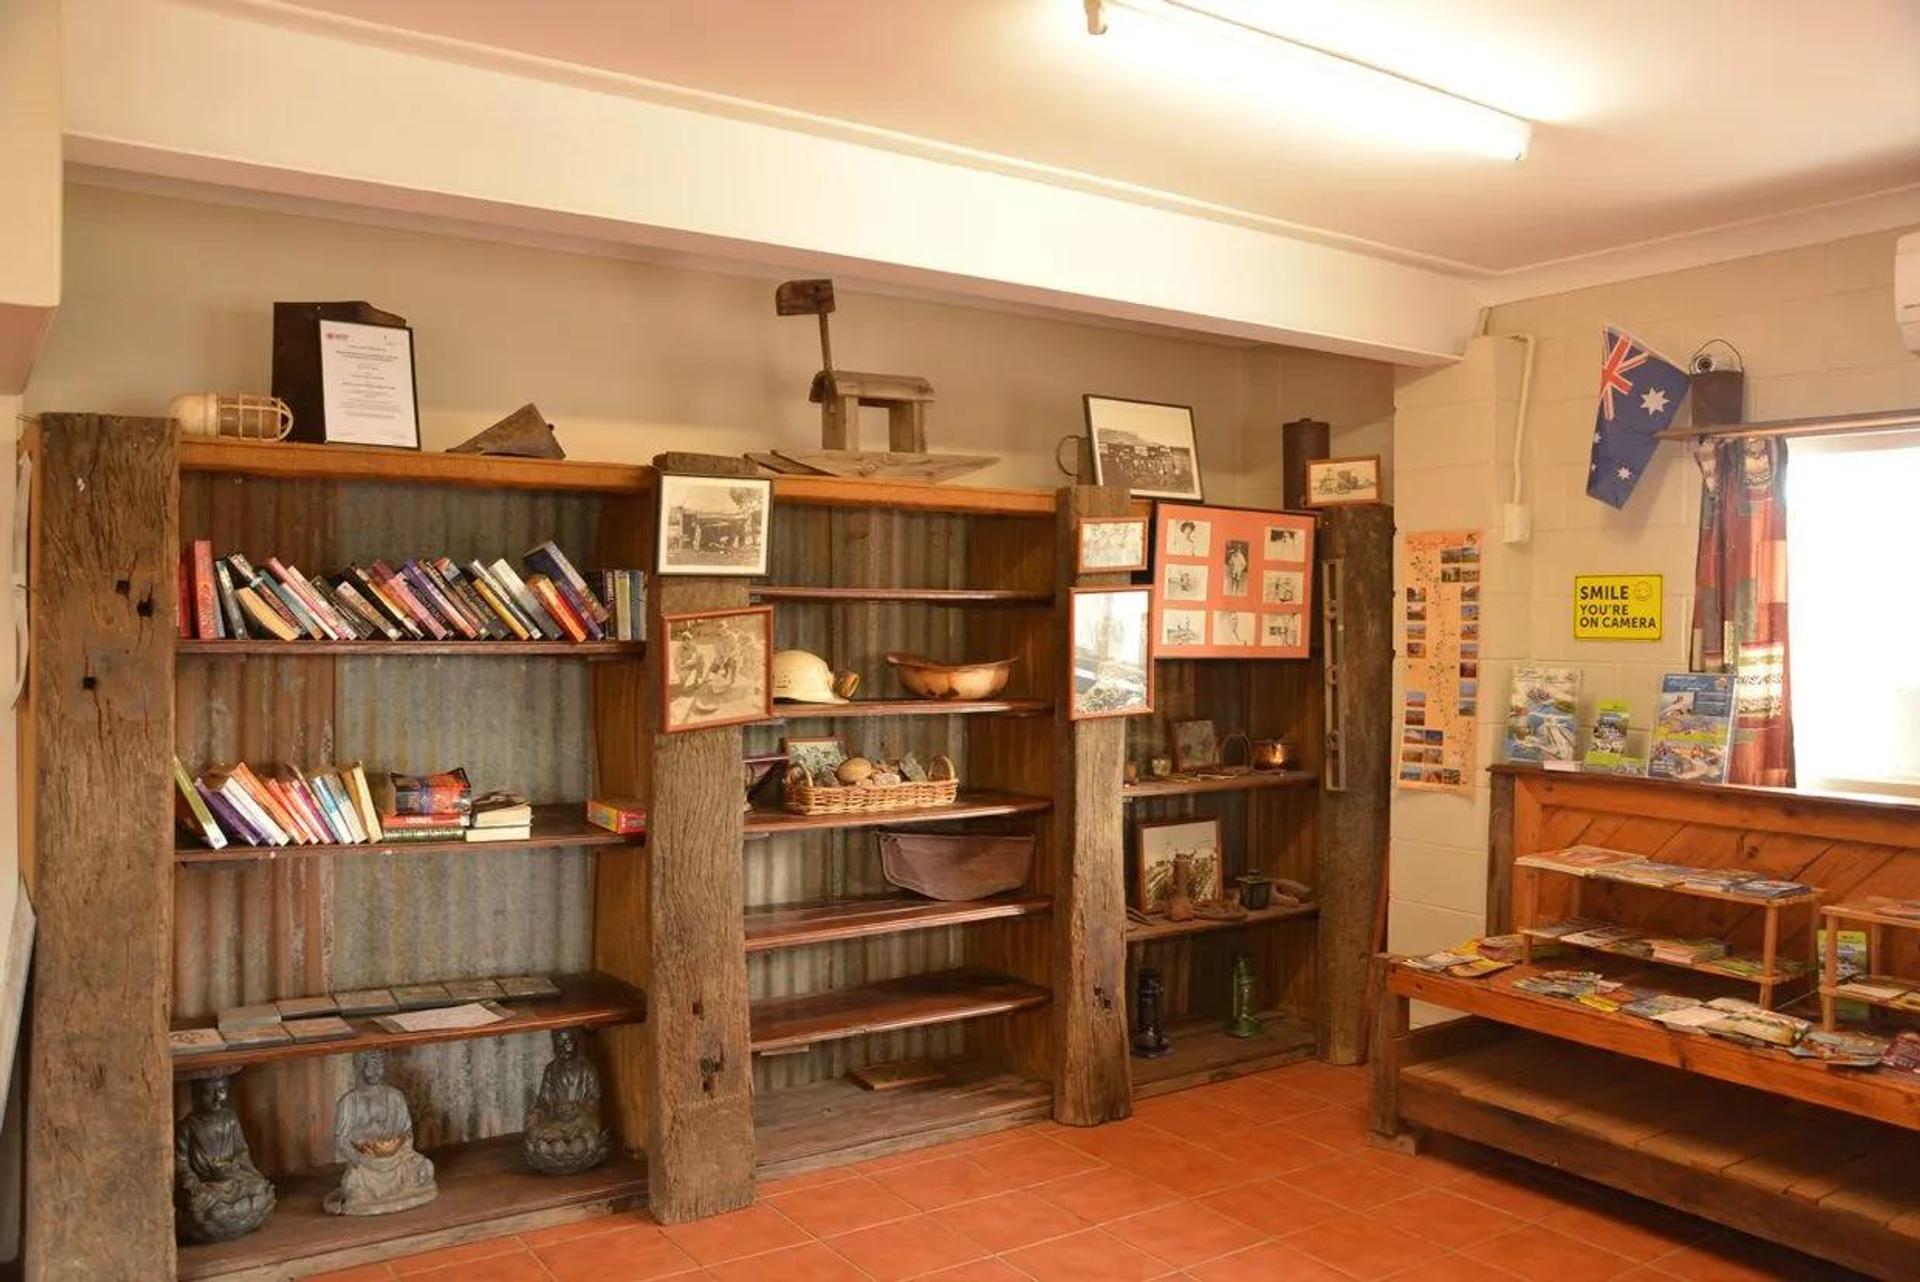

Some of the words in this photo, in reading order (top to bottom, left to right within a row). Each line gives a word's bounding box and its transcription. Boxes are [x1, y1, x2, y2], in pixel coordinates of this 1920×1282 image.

[1580, 585, 1629, 600] SMILE
[1580, 604, 1629, 616] YOU'RE
[1579, 617, 1599, 628] ON
[1602, 617, 1656, 628] CAMERA
